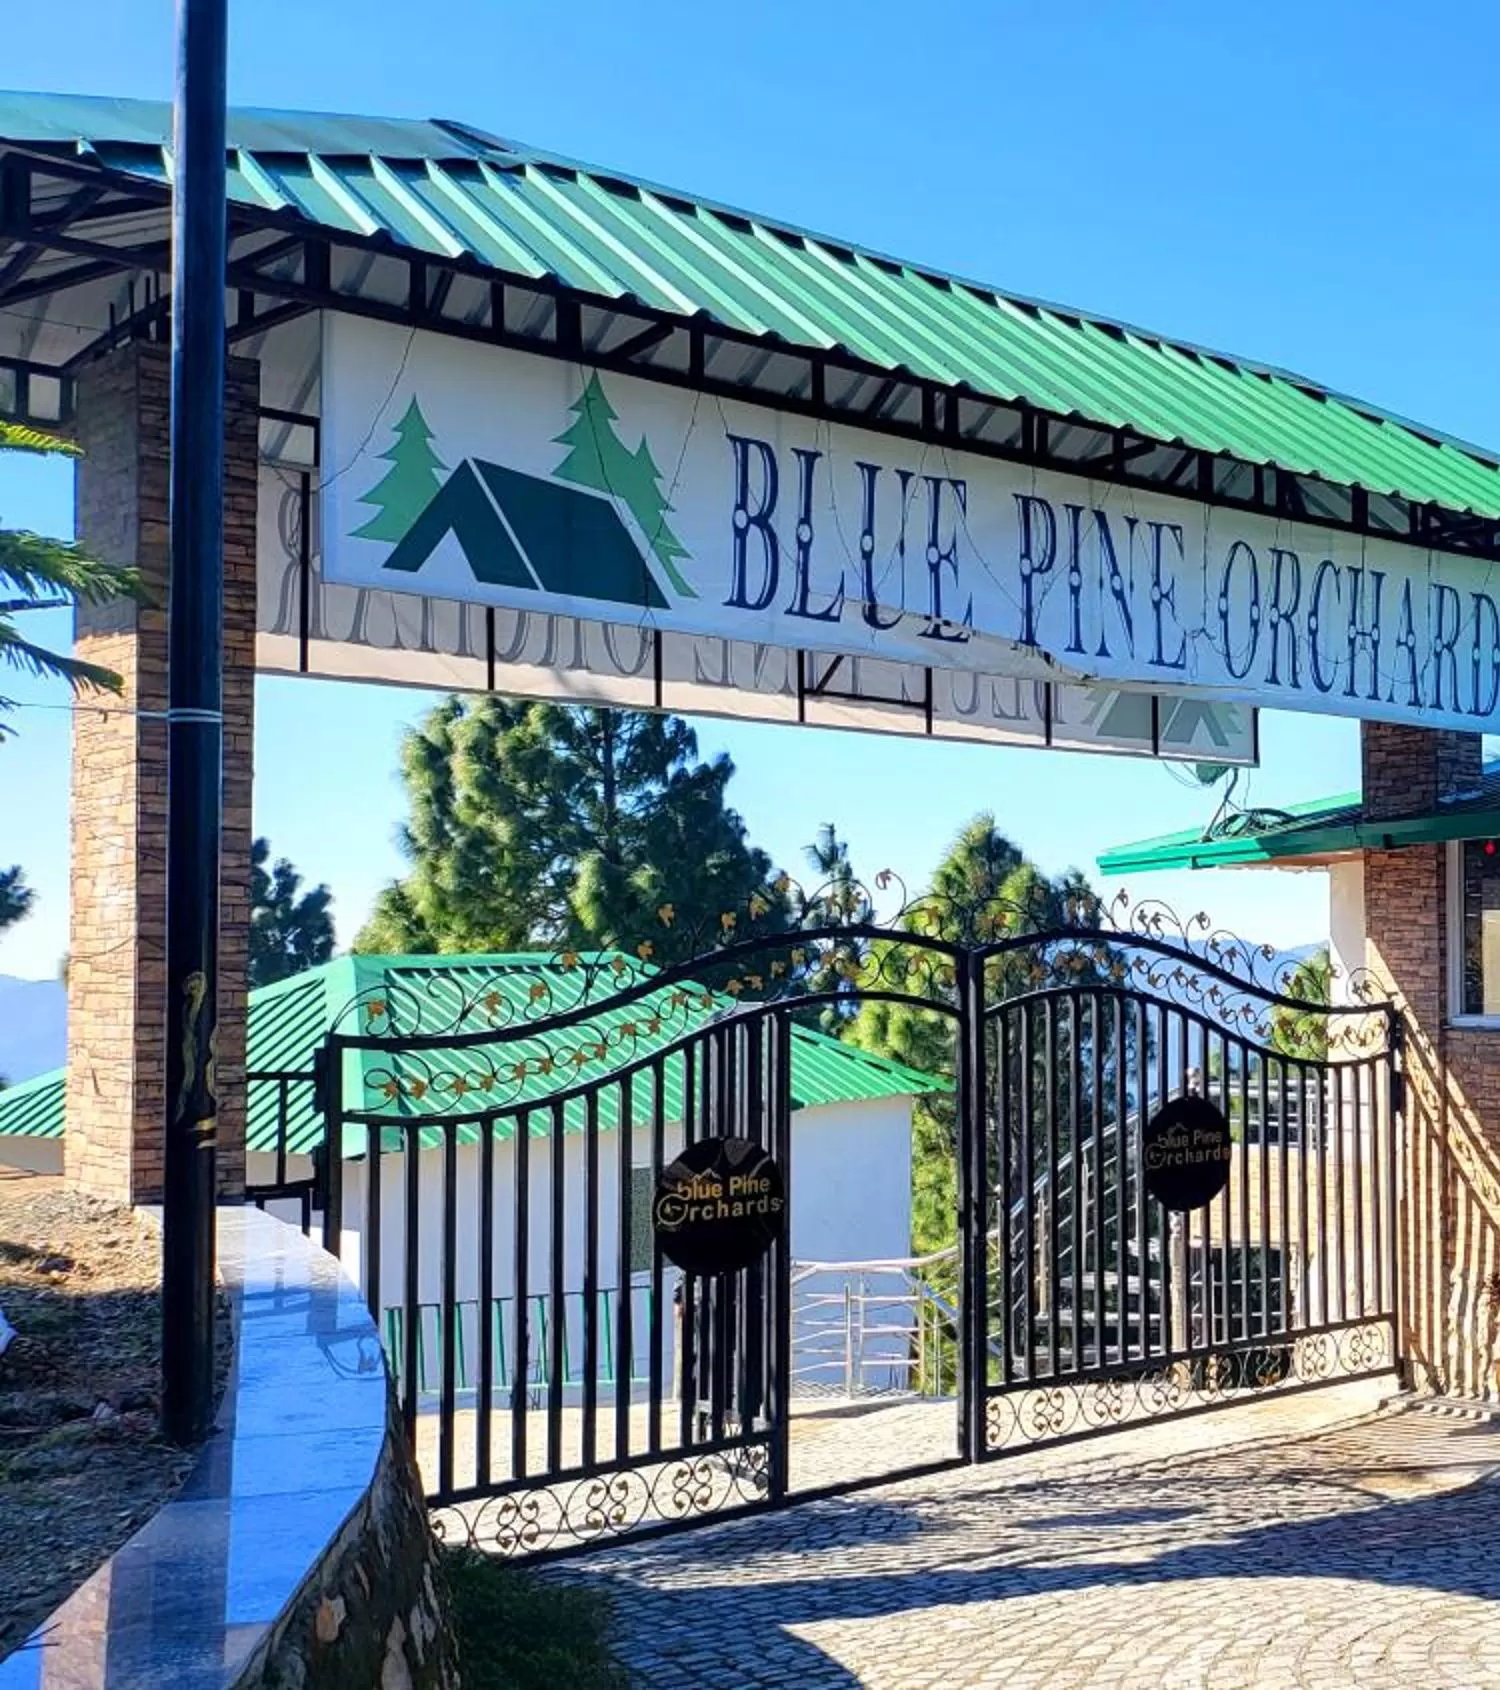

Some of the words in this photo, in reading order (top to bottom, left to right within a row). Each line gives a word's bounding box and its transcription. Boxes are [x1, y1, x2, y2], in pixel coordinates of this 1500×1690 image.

[722, 433, 973, 643] BLUE
[1011, 493, 1187, 670] PINE
[729, 1173, 771, 1197] Pine
[656, 1193, 781, 1226] Orchards
